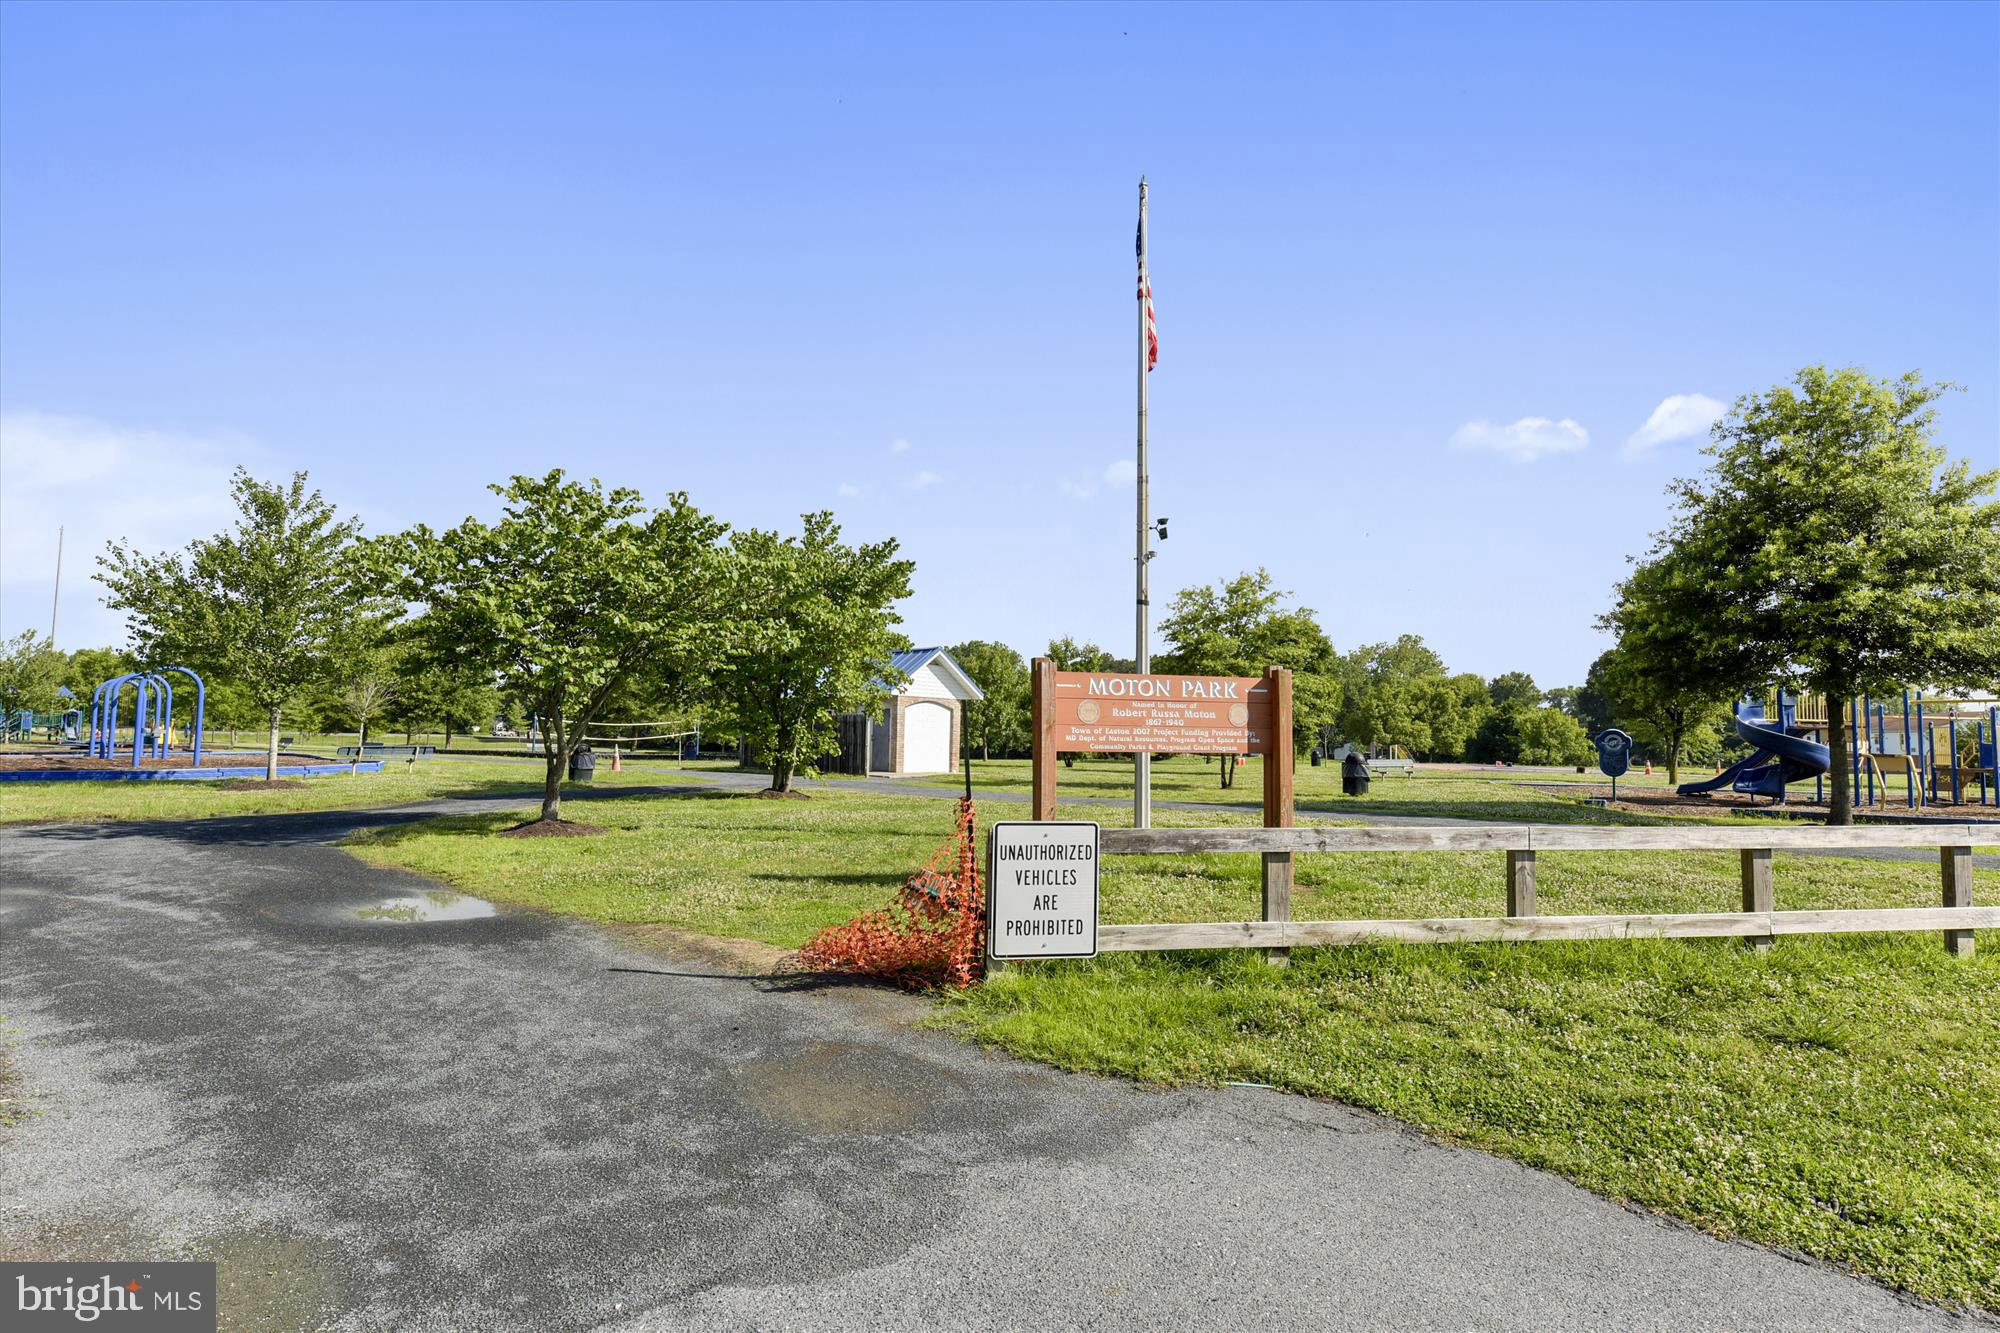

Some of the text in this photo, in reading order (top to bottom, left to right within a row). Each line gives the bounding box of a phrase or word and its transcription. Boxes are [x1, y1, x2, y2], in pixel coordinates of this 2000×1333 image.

[1088, 678, 1239, 699] MOTON PARK
[1112, 708, 1216, 719] Robert Russa Moton
[1153, 728, 1178, 737] Project
[1182, 729, 1209, 737] Funding
[1089, 743, 1126, 751] Community
[1000, 844, 1092, 861] UNAUTHORIZED
[1015, 869, 1077, 886] VEHICLES
[1033, 895, 1058, 910] ARE
[1006, 919, 1083, 936] PROHIBITED
